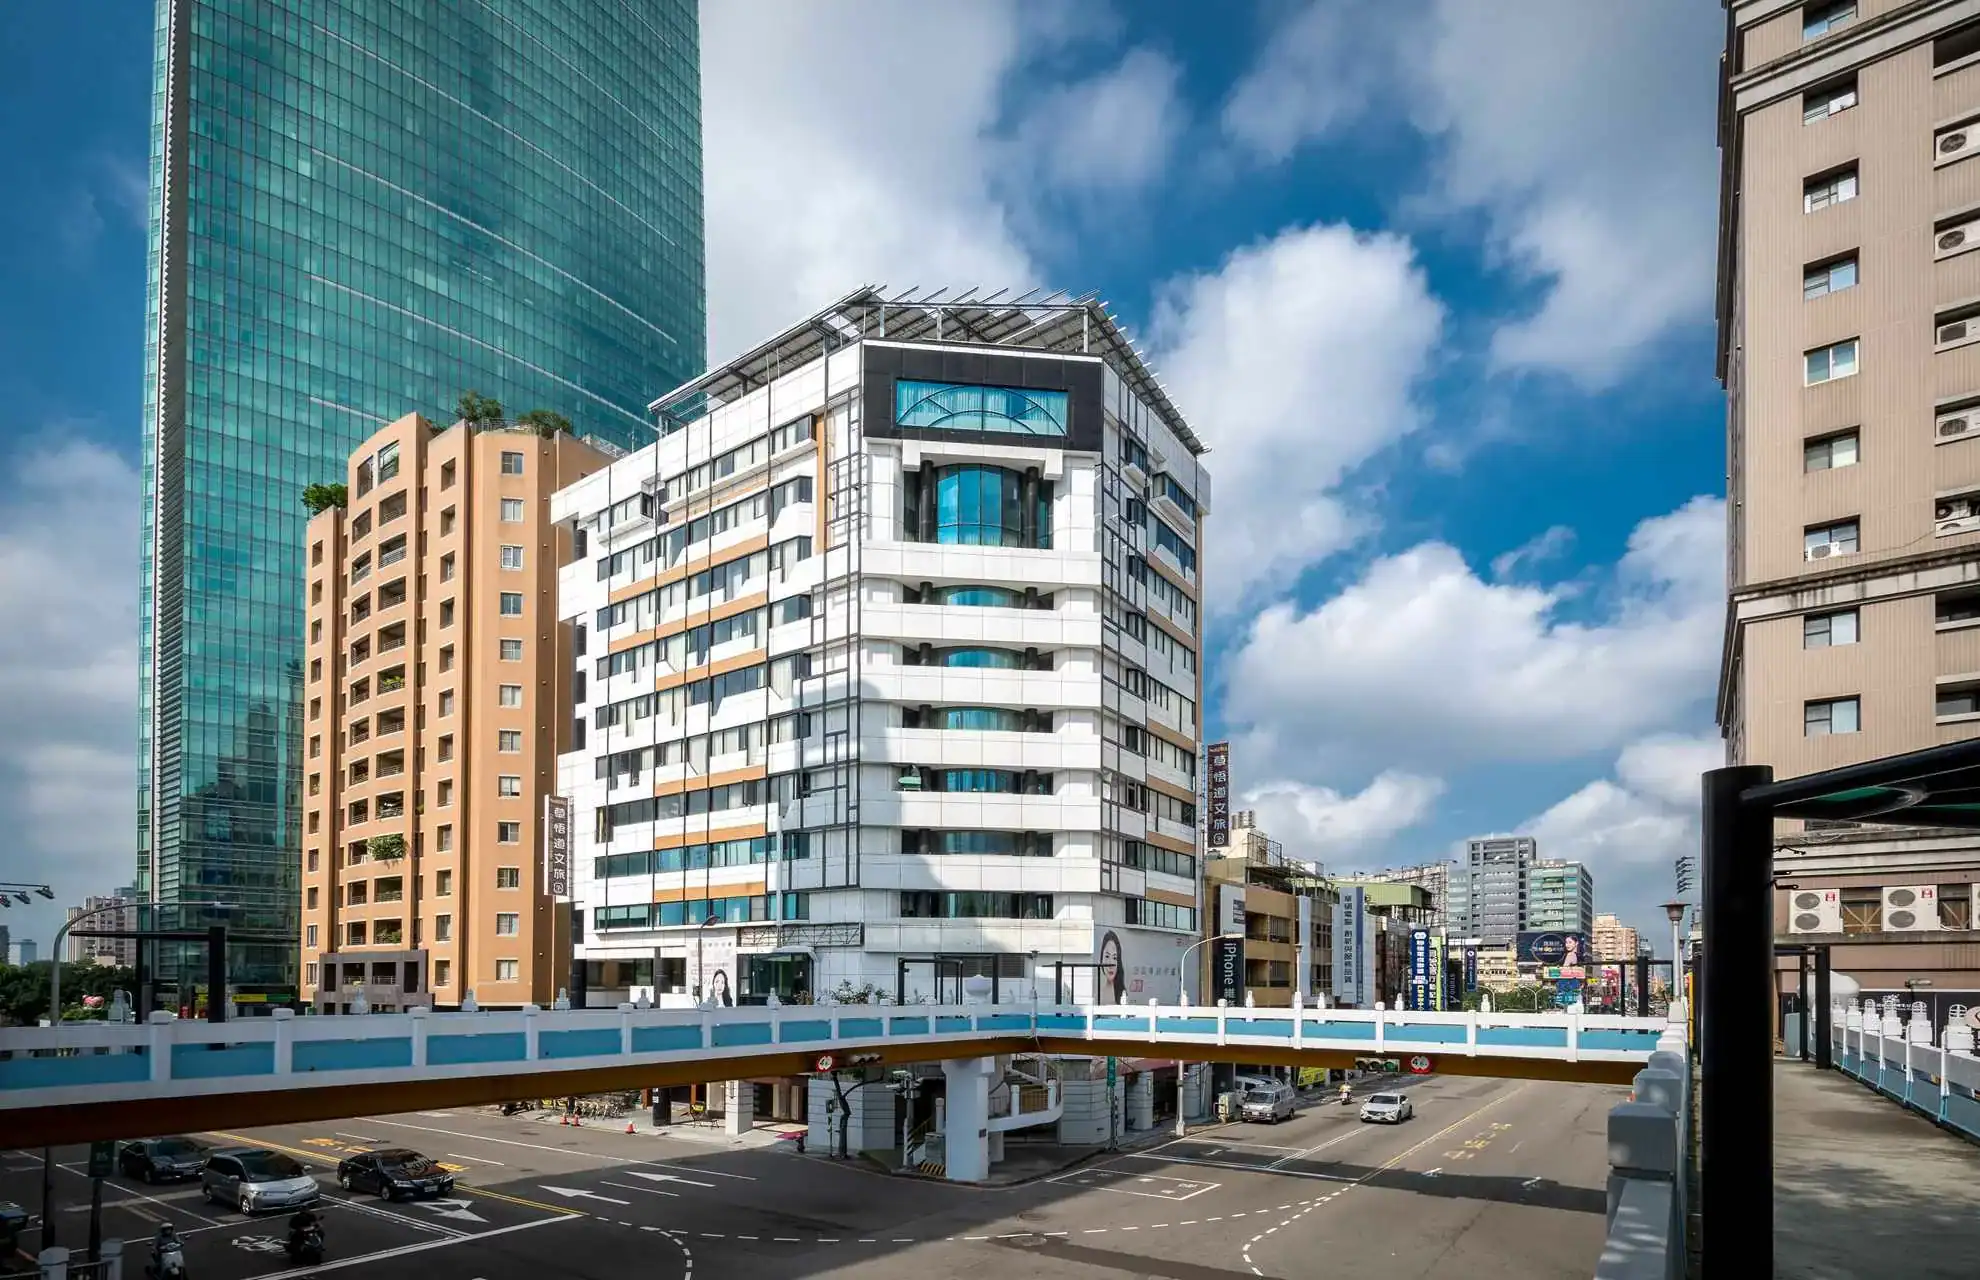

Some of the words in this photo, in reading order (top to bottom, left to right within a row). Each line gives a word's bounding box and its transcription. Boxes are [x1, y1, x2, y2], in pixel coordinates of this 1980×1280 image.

[1213, 755, 1226, 829] 草悟道文旅
[1223, 942, 1237, 985] iPhone
